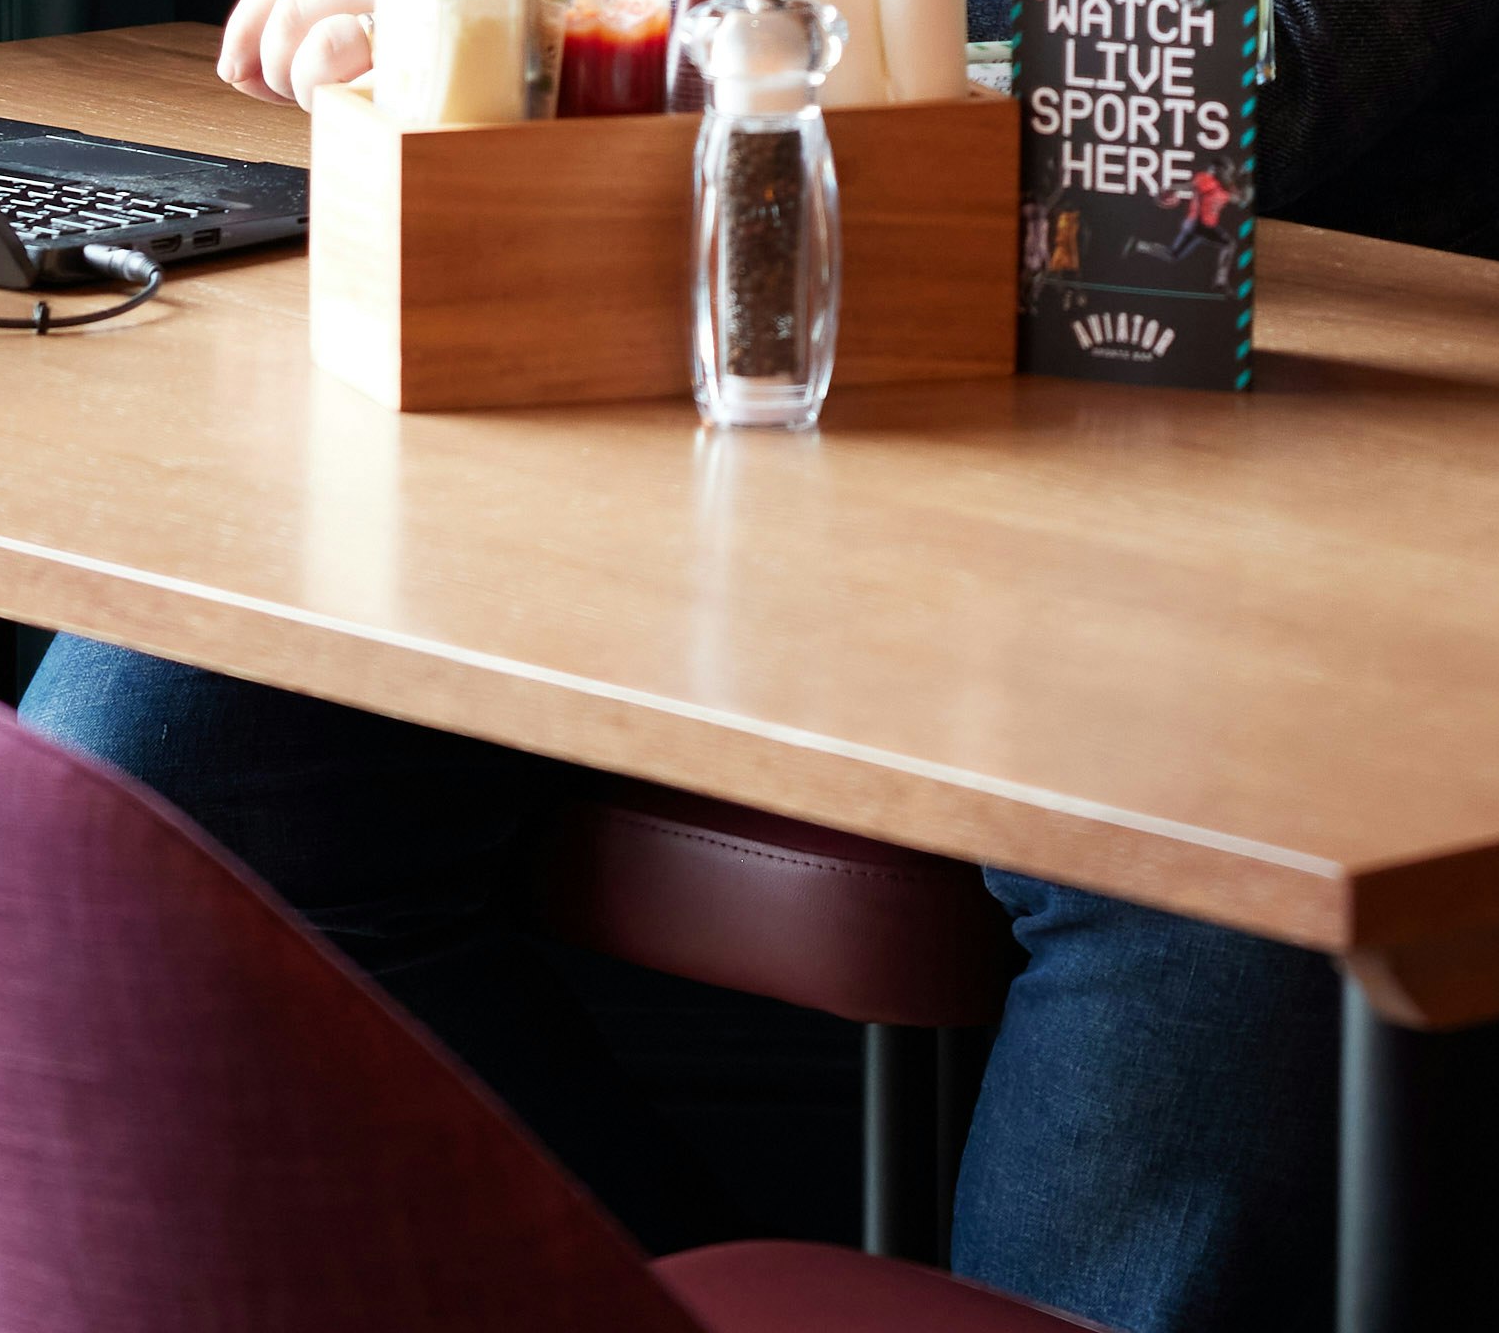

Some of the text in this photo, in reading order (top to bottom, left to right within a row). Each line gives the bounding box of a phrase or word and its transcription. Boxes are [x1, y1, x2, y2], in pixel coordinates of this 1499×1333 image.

[1064, 37, 1196, 98] LIVE
[1031, 86, 1231, 151] SPORTS
[1061, 140, 1195, 200] HERE
